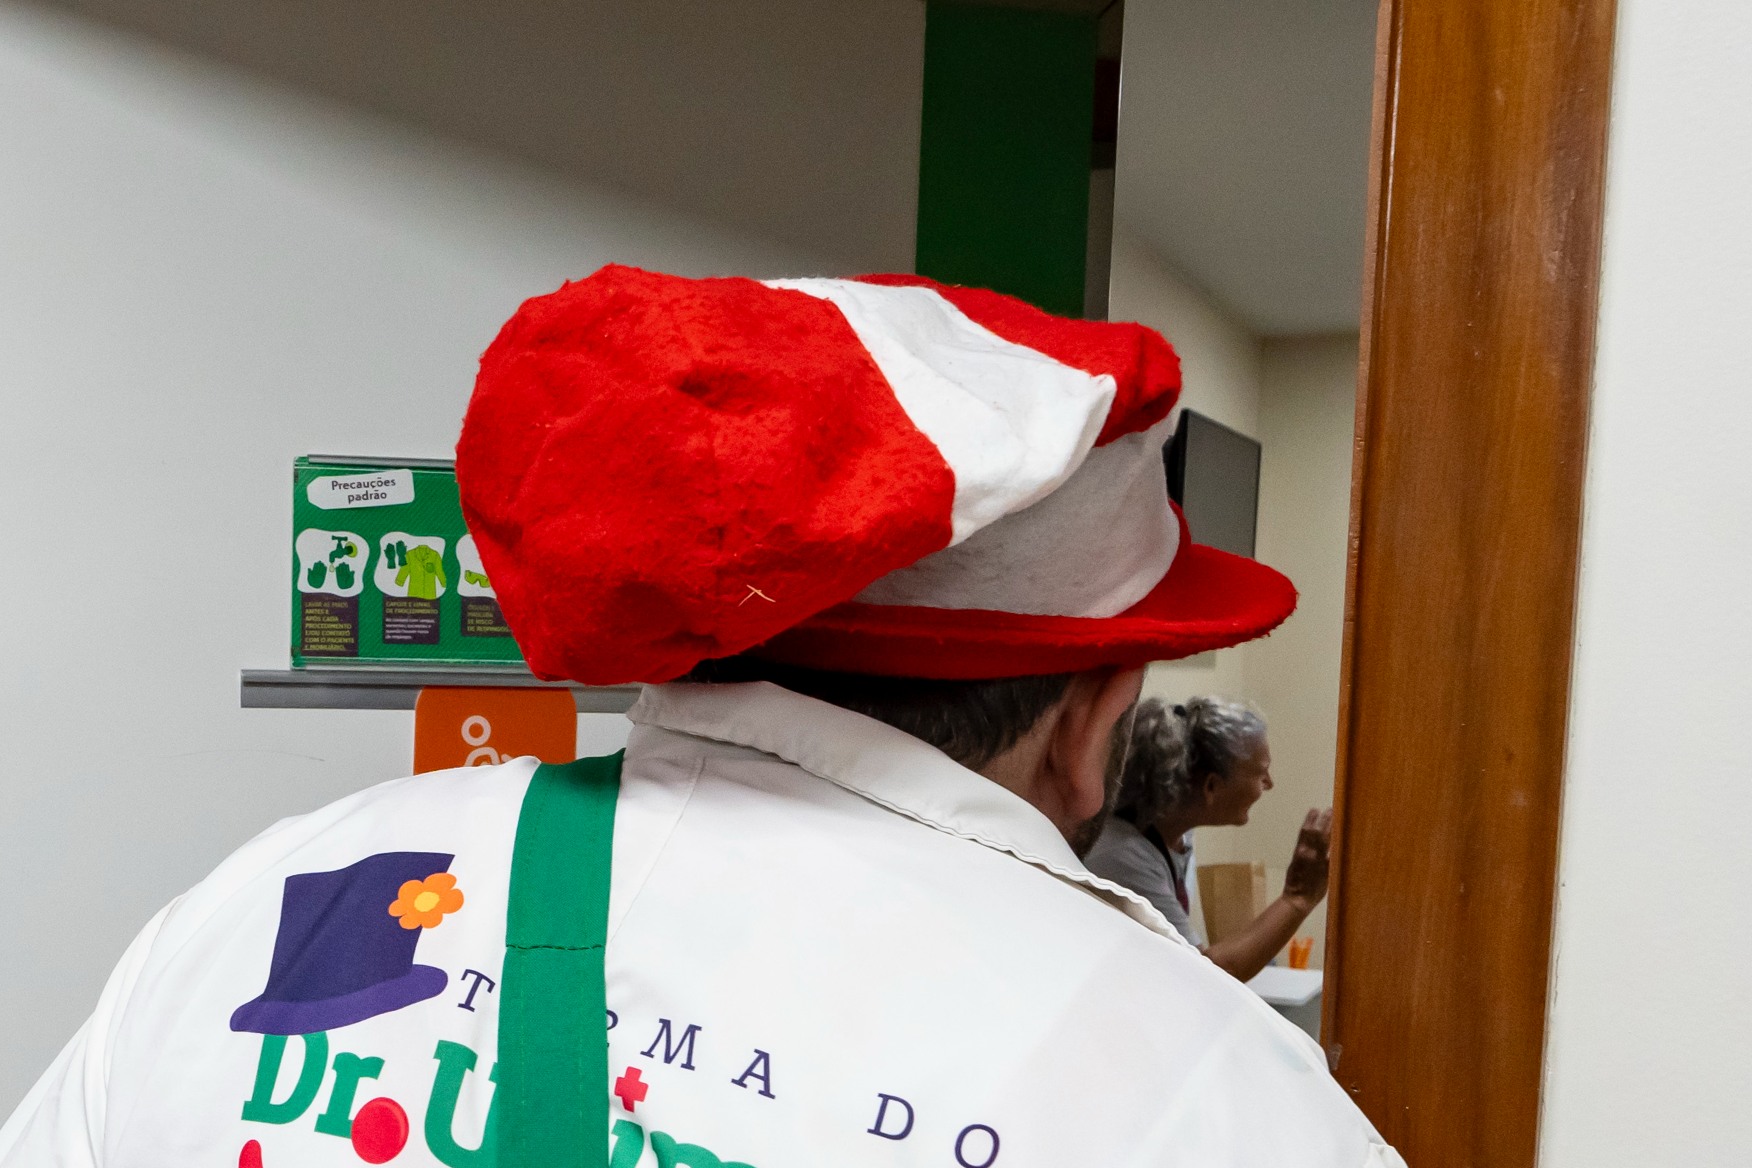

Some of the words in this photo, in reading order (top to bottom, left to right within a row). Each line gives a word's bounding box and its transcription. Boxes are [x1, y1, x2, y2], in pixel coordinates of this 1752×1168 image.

[331, 477, 396, 490] Precauções
[348, 490, 387, 504] padrão
[456, 968, 776, 1099] TMA
